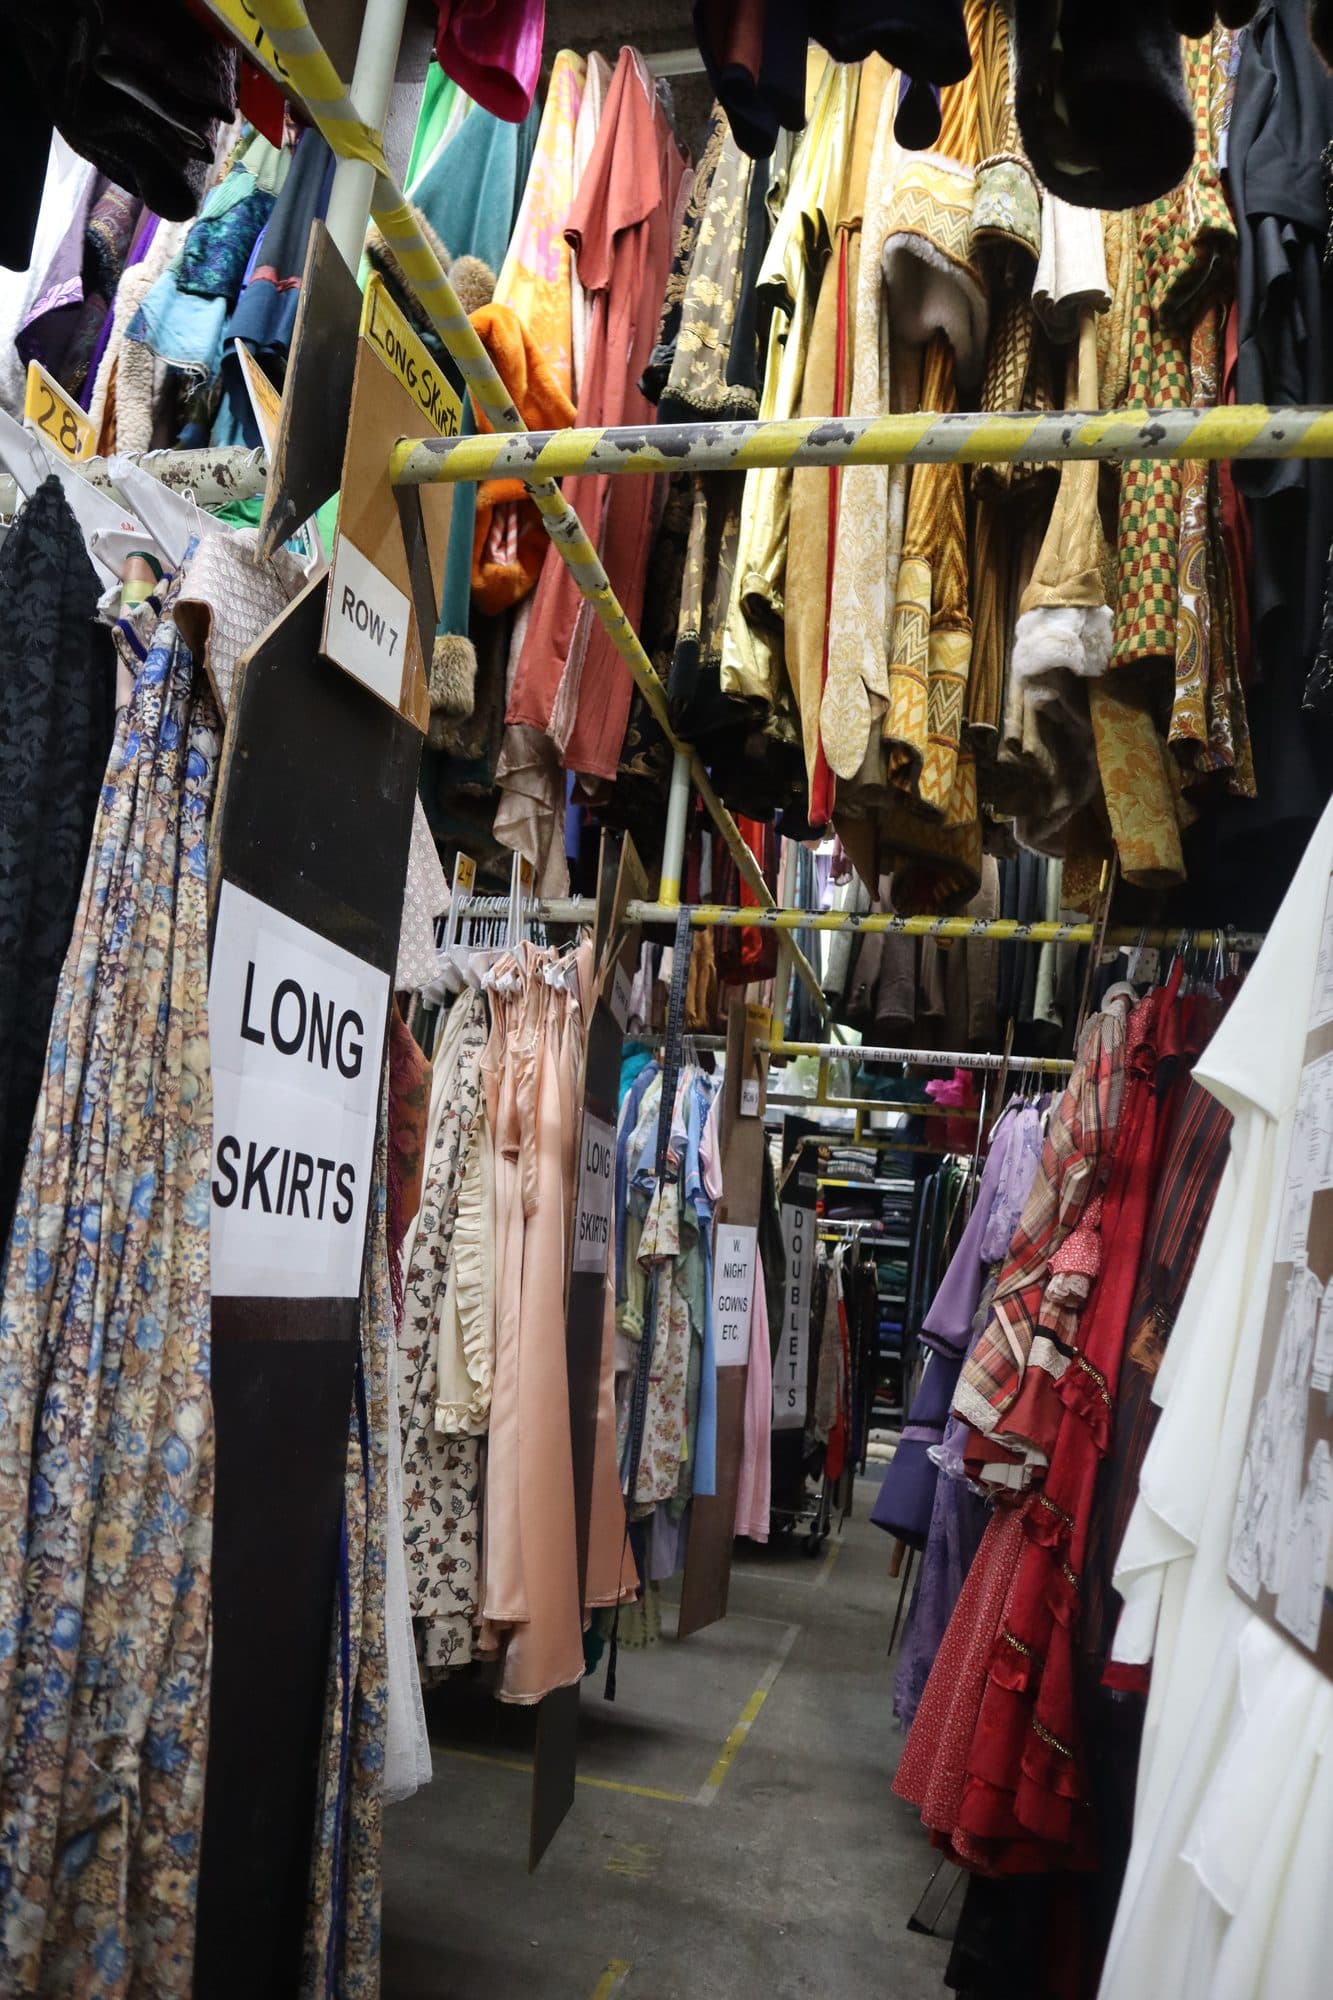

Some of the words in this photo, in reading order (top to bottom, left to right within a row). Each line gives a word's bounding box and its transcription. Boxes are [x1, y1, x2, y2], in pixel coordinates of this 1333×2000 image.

[369, 287, 418, 388] LONG
[37, 385, 82, 455] 28
[341, 584, 386, 647] ROW
[388, 627, 399, 657] 7
[239, 960, 365, 1080] LONG
[829, 1047, 867, 1060] PLEASE
[874, 1050, 918, 1062] RETURN
[926, 1054, 953, 1065] TAPE
[211, 1133, 356, 1225] SKIRTS
[586, 1139, 611, 1179] LONG
[579, 1211, 608, 1244] SKIRTS
[718, 1295, 748, 1313] GOWNS
[723, 1263, 748, 1279] NIGHT
[787, 1209, 804, 1408] DOUBLETS
